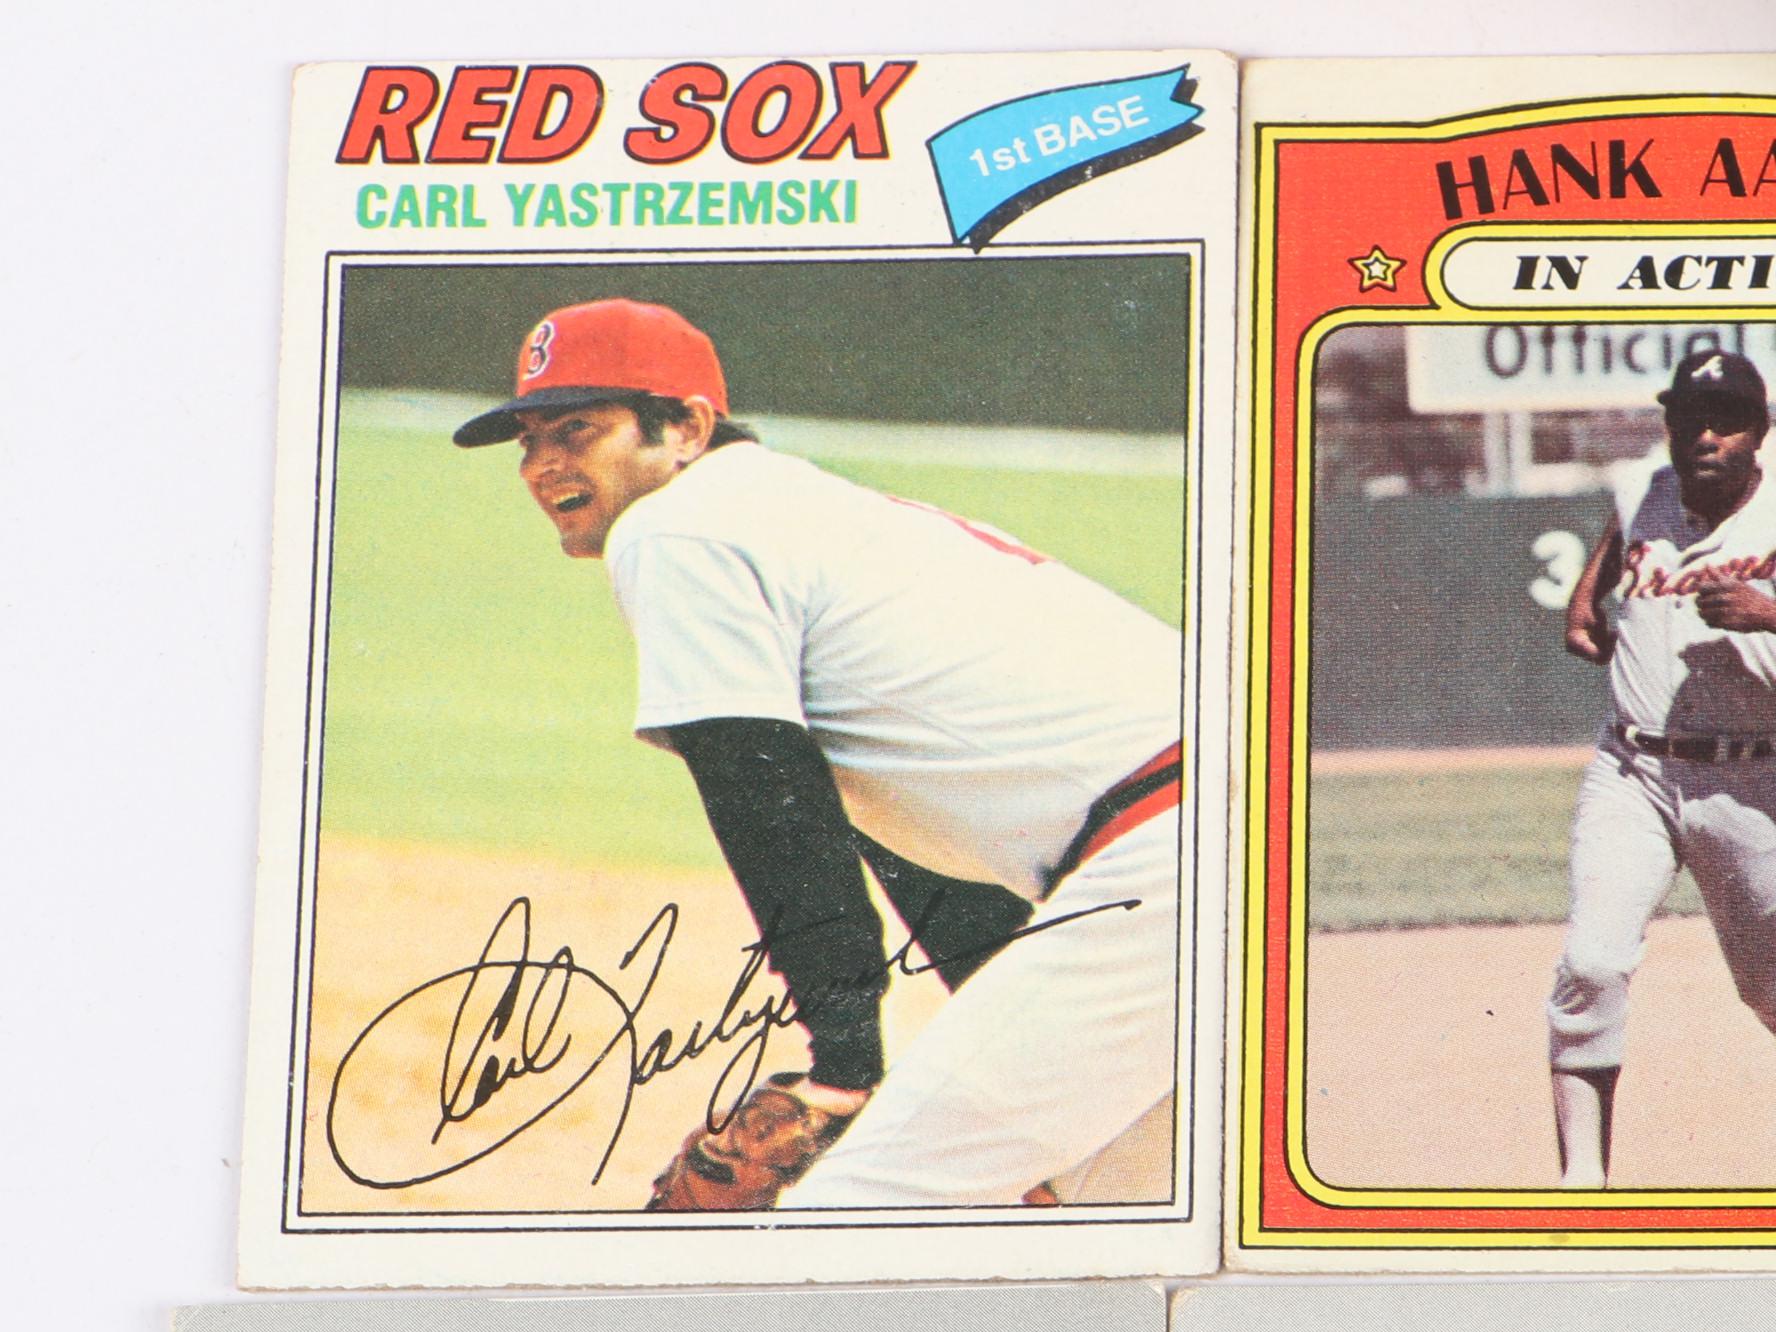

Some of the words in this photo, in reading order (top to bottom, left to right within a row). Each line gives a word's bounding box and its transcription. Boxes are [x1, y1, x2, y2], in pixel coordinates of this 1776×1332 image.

[334, 63, 605, 165] RED
[624, 60, 918, 161] SOX
[967, 135, 1031, 180] 1st
[1034, 94, 1151, 159] BASE
[354, 183, 488, 230] CARL
[503, 179, 859, 227] YASTRZEMSKI
[1435, 137, 1662, 221] HANK
[1513, 254, 1587, 292] IN
[521, 320, 558, 381] B
